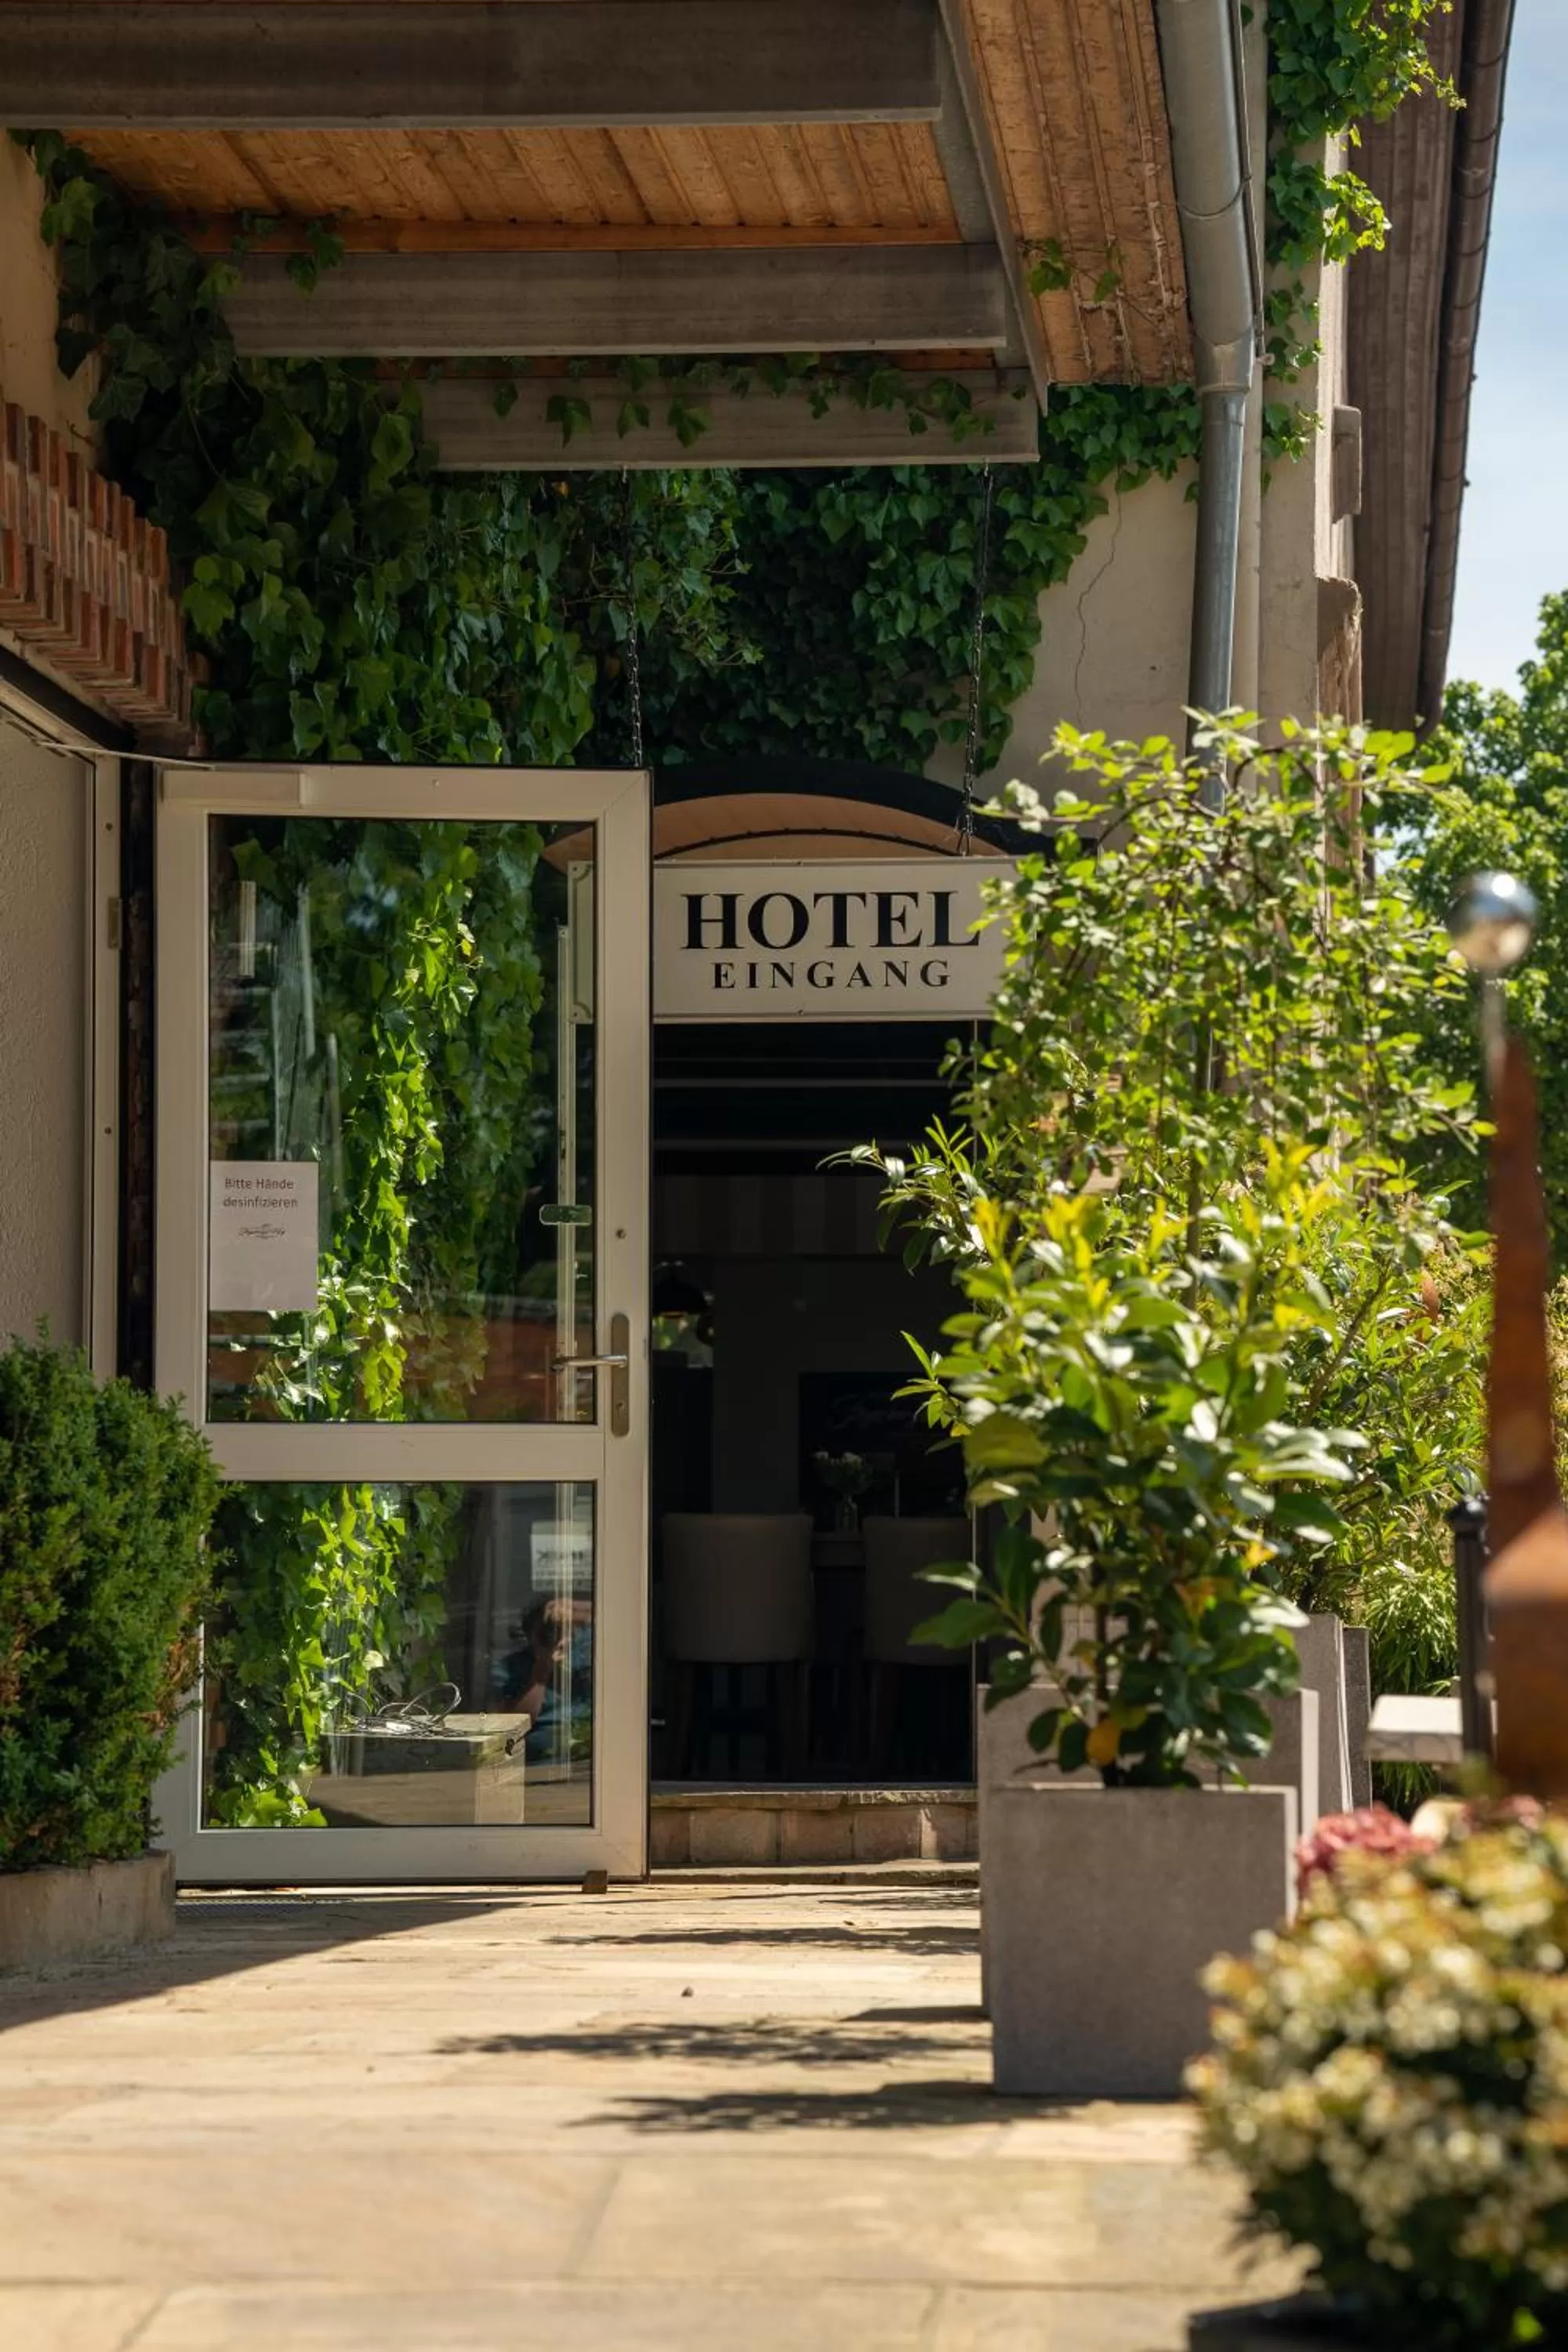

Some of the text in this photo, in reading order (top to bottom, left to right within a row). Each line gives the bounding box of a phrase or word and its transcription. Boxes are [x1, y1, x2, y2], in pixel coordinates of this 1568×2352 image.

[681, 891, 980, 949] HOTEL
[711, 959, 950, 989] EINGANG
[225, 1178, 294, 1189] Bitte Hände
[223, 1196, 298, 1208] desinfizieren
